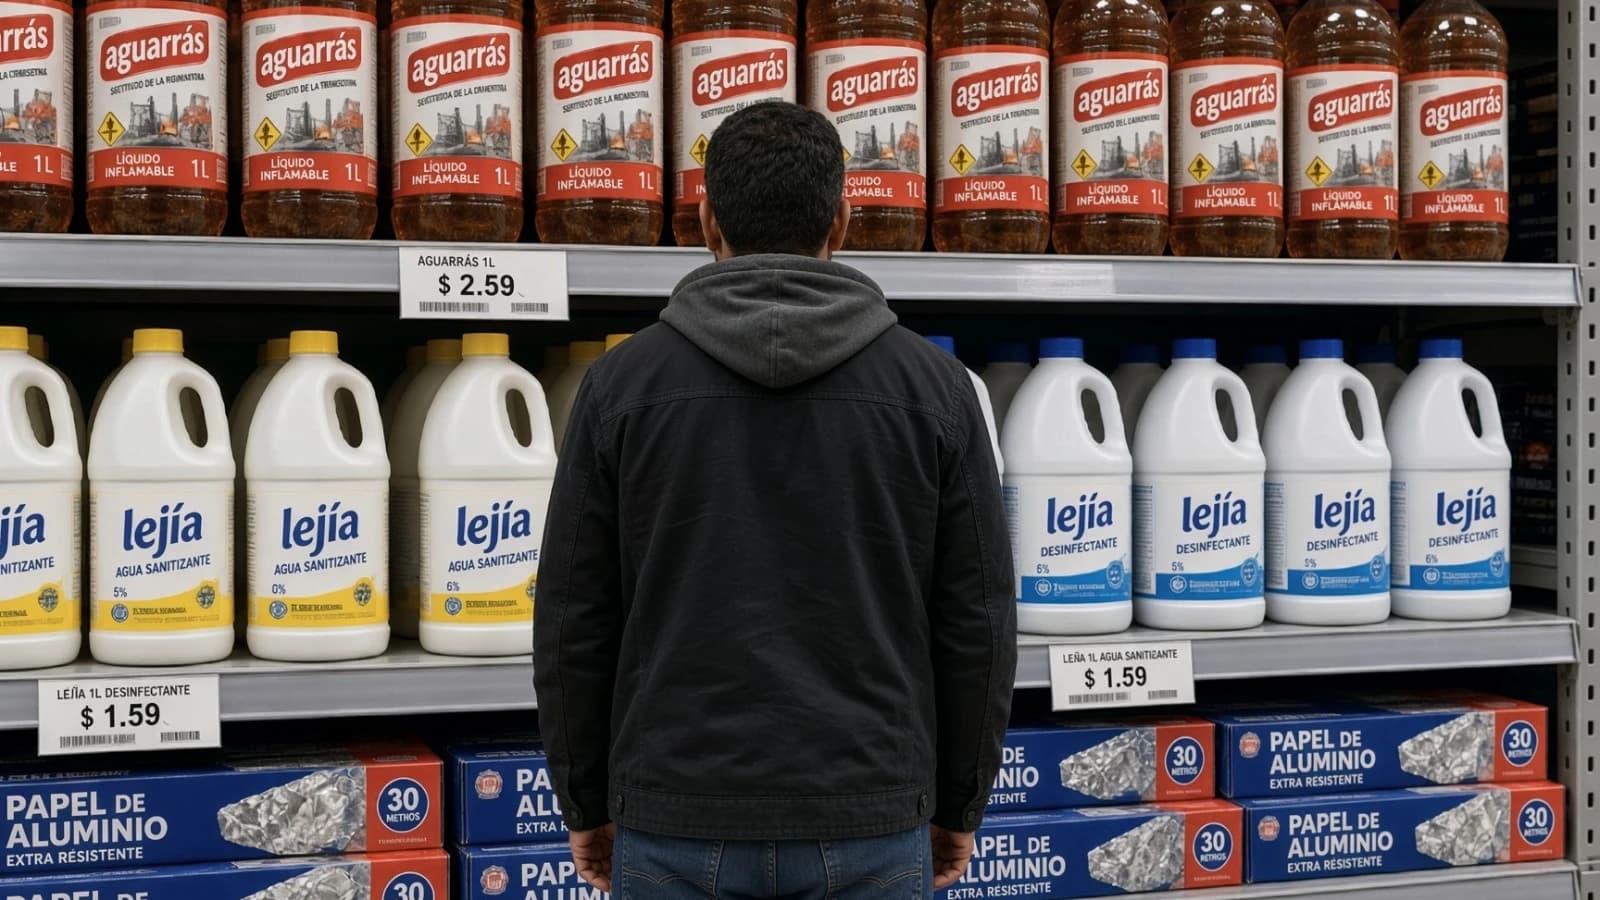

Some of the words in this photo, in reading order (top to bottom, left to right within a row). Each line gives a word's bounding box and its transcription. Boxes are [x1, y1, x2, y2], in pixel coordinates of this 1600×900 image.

[0, 18, 48, 52] rrás
[105, 25, 204, 75] aguarrás
[261, 32, 357, 80] aguarrás
[413, 39, 505, 85] aguarrás
[558, 46, 649, 93] aguarrás
[156, 77, 165, 86] LA
[697, 52, 784, 100] aguarrás
[831, 64, 915, 105] aguarrás
[300, 85, 309, 93] DE
[311, 83, 320, 91] LA
[454, 90, 463, 98] DE
[464, 88, 473, 96] LA
[956, 66, 1038, 110] aguarrás
[1079, 72, 1160, 117] aguarrás
[594, 97, 604, 106] DE
[604, 95, 614, 104] LA
[1196, 78, 1275, 119] aguarrás
[1313, 84, 1391, 125] aguarrás
[1425, 91, 1501, 130] aguarrás
[34, 155, 54, 174] 1L
[116, 153, 160, 165] LÍQUIDO
[271, 157, 314, 170] LÍQUIDO
[423, 160, 467, 173] LÍQUIDO
[105, 165, 174, 179] INFLAMABLE
[192, 160, 209, 178] 1L
[260, 169, 328, 181] INFLAMABLE
[345, 163, 361, 182] 1L
[412, 173, 479, 185] INFLAMABLE
[495, 167, 510, 185] 1L
[569, 166, 611, 178] LÍQUIDO
[558, 178, 623, 190] INFLAMABLE
[639, 171, 653, 190] 1L
[843, 187, 893, 198] LAMABLE
[907, 180, 920, 198] 1L
[844, 176, 881, 187] ÍQUIDO
[965, 179, 1005, 192] LÍQUIDO
[1089, 184, 1128, 195] LÍQUIDO
[955, 191, 1017, 203] INFLAMABLE
[1030, 184, 1041, 201] 1L
[1077, 195, 1139, 206] INFLAMABLE
[1152, 188, 1163, 205] 1L
[1195, 196, 1256, 209] INFLAMABLE
[1267, 191, 1278, 207] 1L
[1206, 186, 1245, 197] LÍQUIDO
[1323, 190, 1361, 202] LÍQUIDO
[1437, 192, 1473, 204] LÍQUIDO
[1312, 200, 1373, 212] INFLAMABLE
[1384, 195, 1394, 211] 1L
[1425, 203, 1484, 214] INFLAMABLE
[1494, 197, 1505, 213] 1L
[418, 254, 478, 267] AGUARRÁS
[483, 257, 495, 267] 1L
[439, 274, 451, 296] $
[460, 274, 514, 296] 2.59
[1047, 493, 1113, 540] lejía
[1182, 491, 1247, 538] lejía
[1315, 489, 1375, 536] lejía
[1437, 487, 1496, 532] lejía
[0, 504, 46, 561] jía
[123, 502, 202, 559] lejía
[282, 501, 359, 557] lejía
[457, 500, 531, 554] lejía
[1041, 537, 1117, 557] DESINFECTANTE
[1177, 535, 1250, 554] DESINFECTANTE
[1307, 531, 1378, 551] DESINFECTANTE
[1429, 528, 1499, 548] DESINFECTANTE
[0, 556, 55, 575] NITIZANTE
[116, 565, 143, 577] AGUA
[146, 554, 210, 574] SANITIZANTE
[274, 563, 301, 575] AGUA
[304, 552, 367, 572] SANITIZANTE
[448, 560, 475, 572] AGUA
[478, 550, 538, 569] SANITIZANTE
[1037, 564, 1049, 574] 6%
[1172, 561, 1184, 571] 5%
[114, 587, 127, 597] 5%
[447, 581, 459, 592] 6%
[1088, 652, 1098, 662] 1L
[1100, 652, 1123, 662] AGUA
[1085, 668, 1095, 689] $
[1104, 667, 1147, 688] 1.59
[90, 689, 101, 698] 1L
[105, 685, 190, 698] DESINFECTANTE
[81, 705, 93, 730] $
[105, 703, 160, 727] 1.59
[1270, 730, 1333, 752] PAPEL
[1340, 730, 1361, 746] DE
[1510, 728, 1530, 748] 30
[1003, 747, 1024, 764] DE
[1173, 746, 1196, 766] 30
[1270, 750, 1375, 774] ALUMINIO
[1270, 777, 1302, 789] EXTRA
[7, 791, 105, 820] PAPEL
[116, 793, 145, 813] DE
[388, 787, 419, 812] 30
[1289, 812, 1351, 835] PAPEL
[1358, 813, 1379, 828] DE
[1526, 807, 1547, 827] 30
[6, 817, 168, 849] ALUMINIO
[516, 824, 557, 834] EXTRA
[1028, 836, 1050, 853] DE
[1201, 831, 1224, 853] 30
[1288, 832, 1393, 858] ALUMINIO
[7, 856, 53, 867] EXTRA
[1288, 861, 1319, 873] EXTRA
[947, 887, 984, 900] EXTRA
